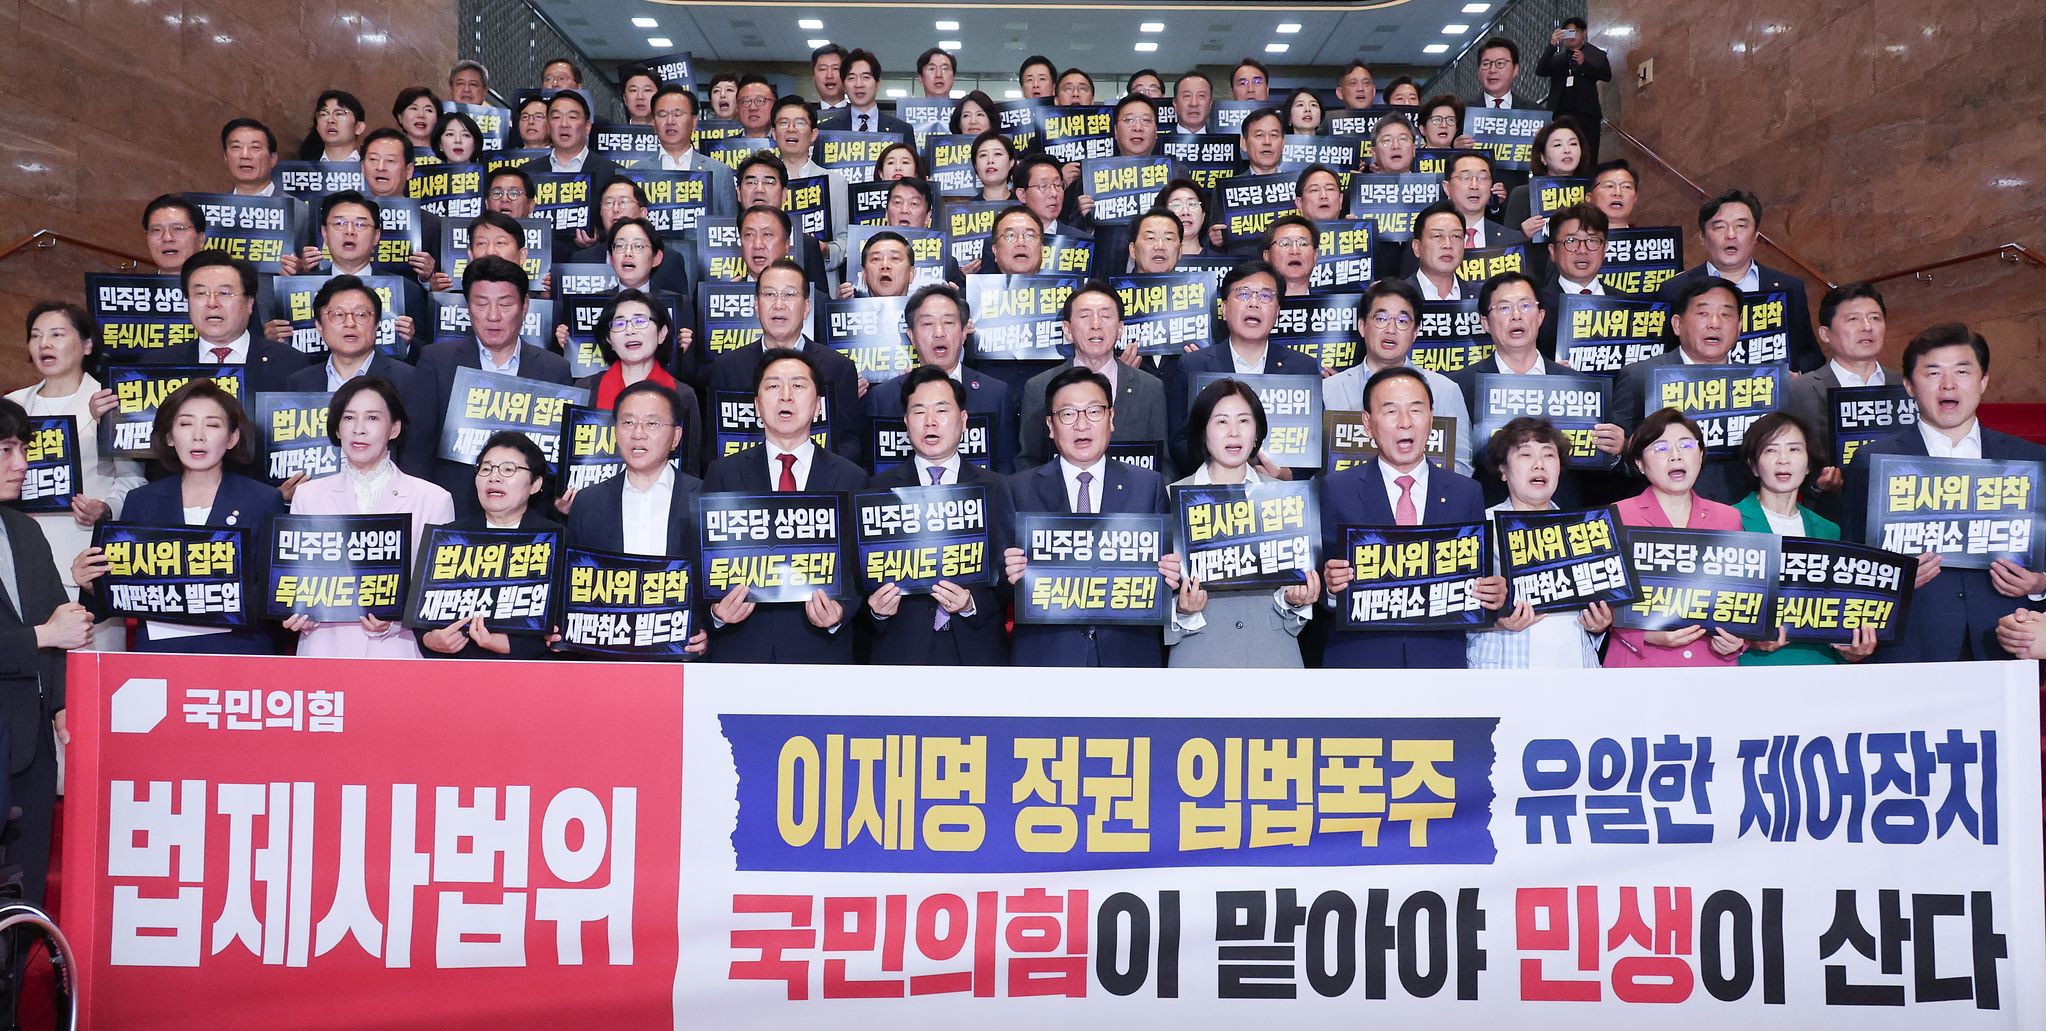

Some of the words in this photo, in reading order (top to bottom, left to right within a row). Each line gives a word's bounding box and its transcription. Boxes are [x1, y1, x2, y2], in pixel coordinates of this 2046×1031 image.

[905, 107, 938, 123] 민주당
[1045, 116, 1084, 139] 법사위
[1087, 115, 1112, 134] 집착
[1332, 118, 1366, 135] 민주당
[1473, 116, 1507, 134] 민주당
[597, 133, 632, 151] 민주당
[824, 141, 863, 163] 법사위
[1045, 141, 1085, 162] 재판취소
[1087, 138, 1115, 157] 빌드업
[1202, 143, 1234, 162] 상임위
[1282, 145, 1317, 163] 민주당
[1319, 146, 1353, 165] 상임위
[282, 171, 322, 191] 민주당
[325, 171, 365, 192] 상임위
[408, 174, 448, 199] 법사위
[451, 172, 480, 194] 집착
[560, 181, 588, 203] 집착
[644, 181, 671, 204] 사위
[675, 180, 703, 203] 집착
[1093, 167, 1138, 193] 법사위
[1141, 165, 1168, 186] 집착
[448, 197, 482, 217] 빌드업
[795, 184, 821, 210] 집착
[1226, 185, 1262, 207] 민주당
[1360, 184, 1399, 204] 민주당
[1402, 183, 1440, 203] 상임위
[239, 206, 285, 230] 상임위
[379, 209, 411, 230] 임위
[555, 206, 589, 230] 빌드업
[802, 210, 824, 234] 드업
[1094, 195, 1139, 221] 재판취소
[951, 211, 994, 236] 법사위
[250, 239, 283, 261] 중단!
[377, 240, 411, 262] 중단!
[912, 238, 942, 261] 집착
[1338, 229, 1369, 255] 집착
[1604, 240, 1631, 262] 주당
[1634, 238, 1675, 260] 상임위
[1059, 248, 1090, 271] 집착
[1336, 257, 1372, 284] 빌드업
[1455, 258, 1485, 281] 사위
[562, 275, 606, 295] 민주당
[1171, 282, 1206, 311] 집착
[99, 287, 151, 311] 민주당
[154, 287, 189, 312] 상임
[710, 294, 756, 317] 민주당
[980, 287, 1036, 319] 법사위
[440, 305, 471, 331] 민주
[1170, 313, 1210, 345] 빌드업
[1270, 309, 1308, 333] 주당
[1311, 307, 1358, 332] 상임위
[1455, 311, 1486, 335] 상임
[1572, 310, 1629, 339] 법사위
[1632, 310, 1667, 337] 집착
[1752, 300, 1783, 332] 집착
[103, 324, 166, 349] 독식시도
[978, 323, 1033, 353] 재판취소
[1749, 333, 1787, 365] 빌드업
[1322, 342, 1357, 368] 중단!
[1568, 347, 1623, 372] 재판취소
[465, 387, 531, 423] 법사위
[1260, 389, 1311, 415] 상임위
[1490, 389, 1545, 415] 민주당
[1547, 390, 1601, 418] 상임위
[1662, 378, 1727, 412] 법사위
[1732, 376, 1774, 408] 집착
[1840, 401, 1893, 427] 민주당
[879, 430, 914, 456] 민주
[1269, 426, 1309, 455] 중단!
[269, 446, 337, 479] 재판취소
[22, 465, 70, 500] 빌드업
[1888, 475, 1970, 512] 법사위
[1976, 475, 2031, 511] 집착
[706, 510, 770, 541] 민주당
[773, 507, 836, 539] 상임위
[861, 504, 921, 537] 민주당
[925, 498, 984, 532] 상임위
[1187, 499, 1256, 542] 법사위
[1260, 495, 1305, 533] 집착
[278, 530, 344, 561] 민주당
[347, 530, 401, 561] 상임위
[1032, 530, 1094, 561] 민주당
[1097, 530, 1159, 562] 상임위
[1508, 523, 1567, 567] 법사위
[1567, 518, 1610, 553] 집착
[1881, 520, 1964, 554] 재판취소
[1966, 518, 2032, 554] 빌드업
[104, 540, 181, 577] 법사위
[186, 541, 236, 577] 집착
[432, 542, 507, 582] 법사위
[506, 541, 551, 578] 집착
[709, 555, 787, 591] 독식시도
[790, 552, 836, 586] 중단!
[866, 544, 938, 584] 독식시도
[941, 542, 984, 577] 중단!
[1188, 545, 1258, 583] 재판취소
[1259, 535, 1310, 575] 빌드업
[1355, 540, 1431, 581] 법사위
[1434, 535, 1480, 577] 집착
[1633, 542, 1698, 574] 민주당
[1700, 547, 1766, 580] 상임위
[571, 567, 637, 604] 법사위
[641, 569, 689, 605] 집착
[1512, 568, 1573, 607] 재판취소
[1572, 556, 1627, 596] 빌드업
[1832, 556, 1901, 591] 상임위
[109, 583, 184, 613] 재판취소
[184, 582, 241, 614] 빌드업
[275, 574, 357, 608] 독식시도
[357, 573, 399, 607] 중단!
[419, 588, 494, 622] 재판취소
[493, 583, 549, 621] 빌드업
[1031, 577, 1108, 610] 독식시도
[1110, 576, 1157, 609] 중단!
[1350, 588, 1426, 622] 재판취소
[1427, 577, 1482, 619] 빌드업
[1712, 587, 1764, 624] 중단!
[1842, 597, 1894, 630] 중단!
[565, 611, 632, 646] 재판취소
[633, 608, 690, 647] 빌드업
[183, 689, 345, 733] 국민의힘
[778, 735, 988, 853] 이재명
[1011, 735, 1151, 854] 정권
[1176, 735, 1457, 853] 입법폭주
[1515, 736, 1716, 846] 유일한
[1737, 729, 1999, 847] 제어장치
[107, 778, 640, 969] 법제사법위
[729, 886, 1181, 1003] 국민의힘이
[1215, 886, 1488, 1001] 맡아야
[1515, 885, 1786, 1006] 민생이
[1819, 888, 2009, 1011] 산다
